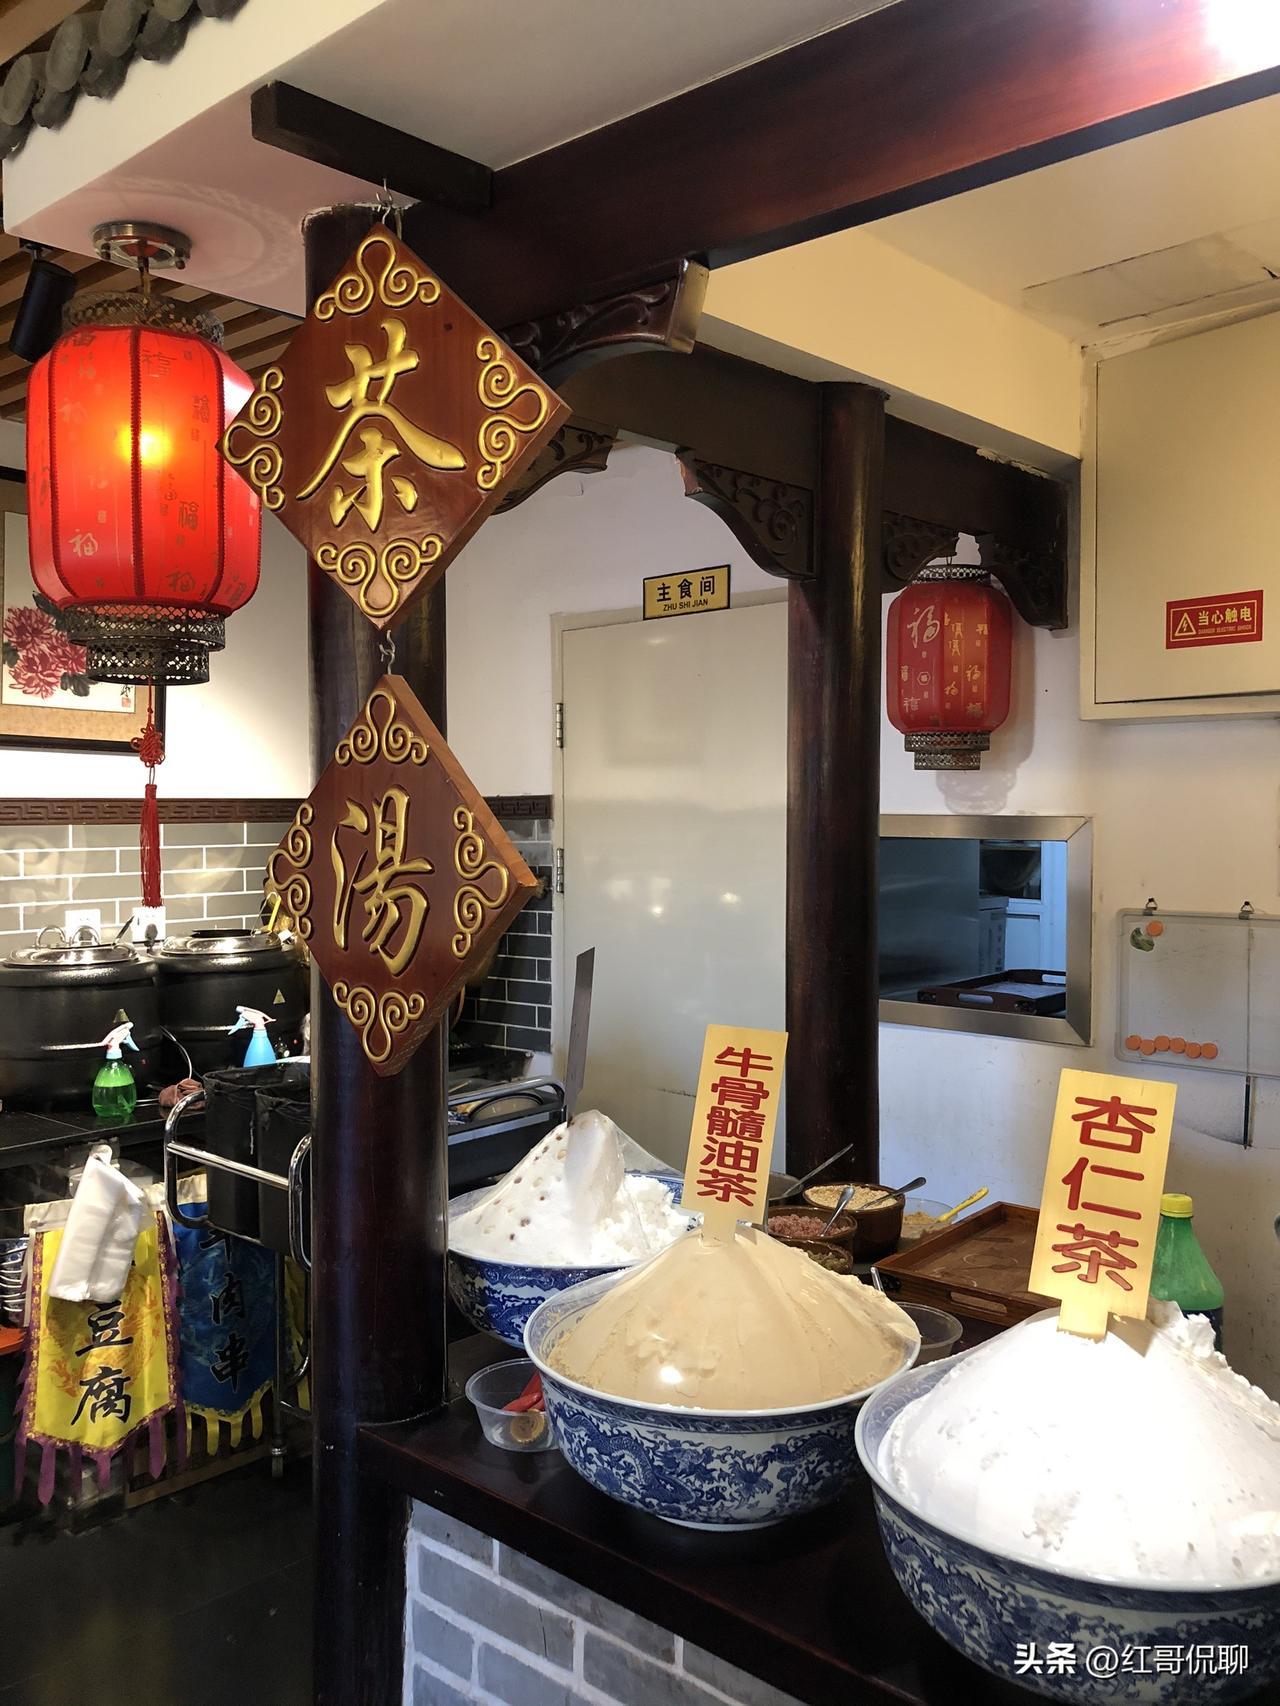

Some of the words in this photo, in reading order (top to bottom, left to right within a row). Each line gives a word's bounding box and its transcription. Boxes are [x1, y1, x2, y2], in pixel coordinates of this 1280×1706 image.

[296, 317, 467, 532] 茶
[656, 576, 715, 602] 主食间
[663, 603, 678, 612] ZHU
[678, 601, 691, 609] SHI
[692, 598, 709, 608] JIAN
[906, 605, 940, 648] 福
[1198, 606, 1252, 626] 当心触电
[330, 786, 435, 977] 湯
[696, 1046, 774, 1207] 牛骨髓油茶
[1051, 1095, 1158, 1291] 杏仁茶
[71, 1300, 134, 1426] 豆腐
